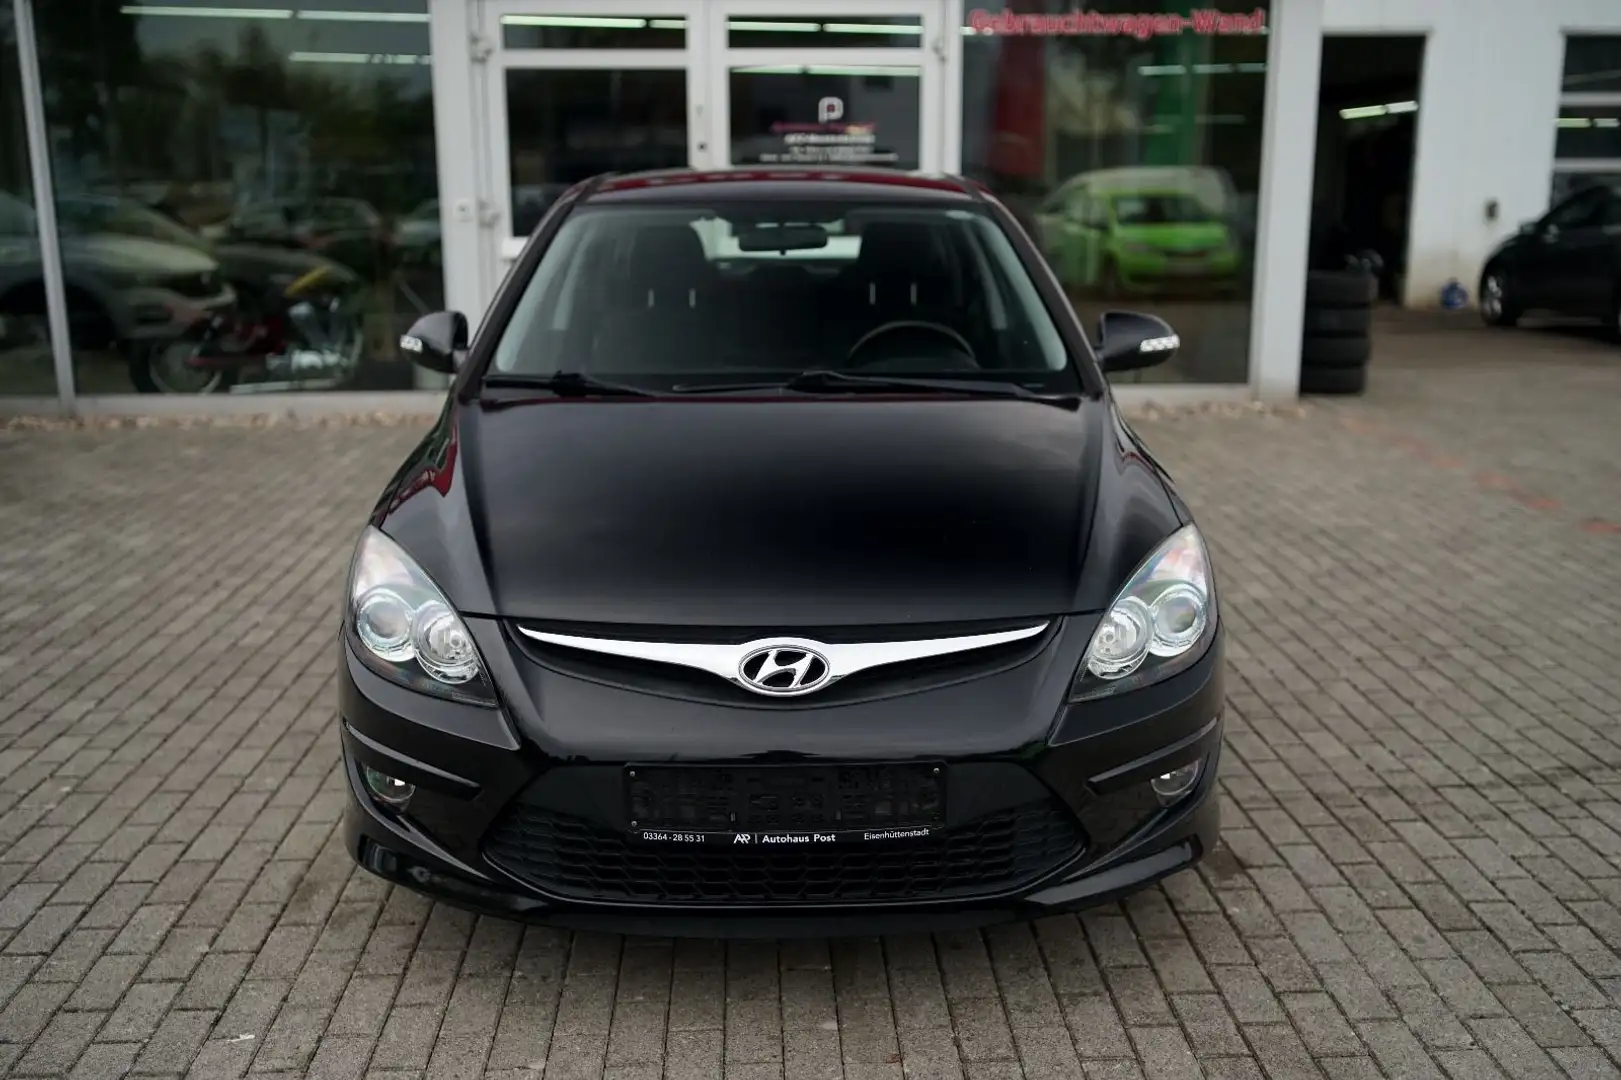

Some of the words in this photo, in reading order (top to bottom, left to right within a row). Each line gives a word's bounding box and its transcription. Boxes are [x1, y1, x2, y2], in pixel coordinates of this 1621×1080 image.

[969, 9, 1266, 38] Gebrauchtwagen-Wand
[643, 832, 668, 840] 03364
[762, 834, 810, 844] Autohaus
[813, 833, 836, 842] Post
[864, 828, 929, 840] Eisenhüttenstadt
